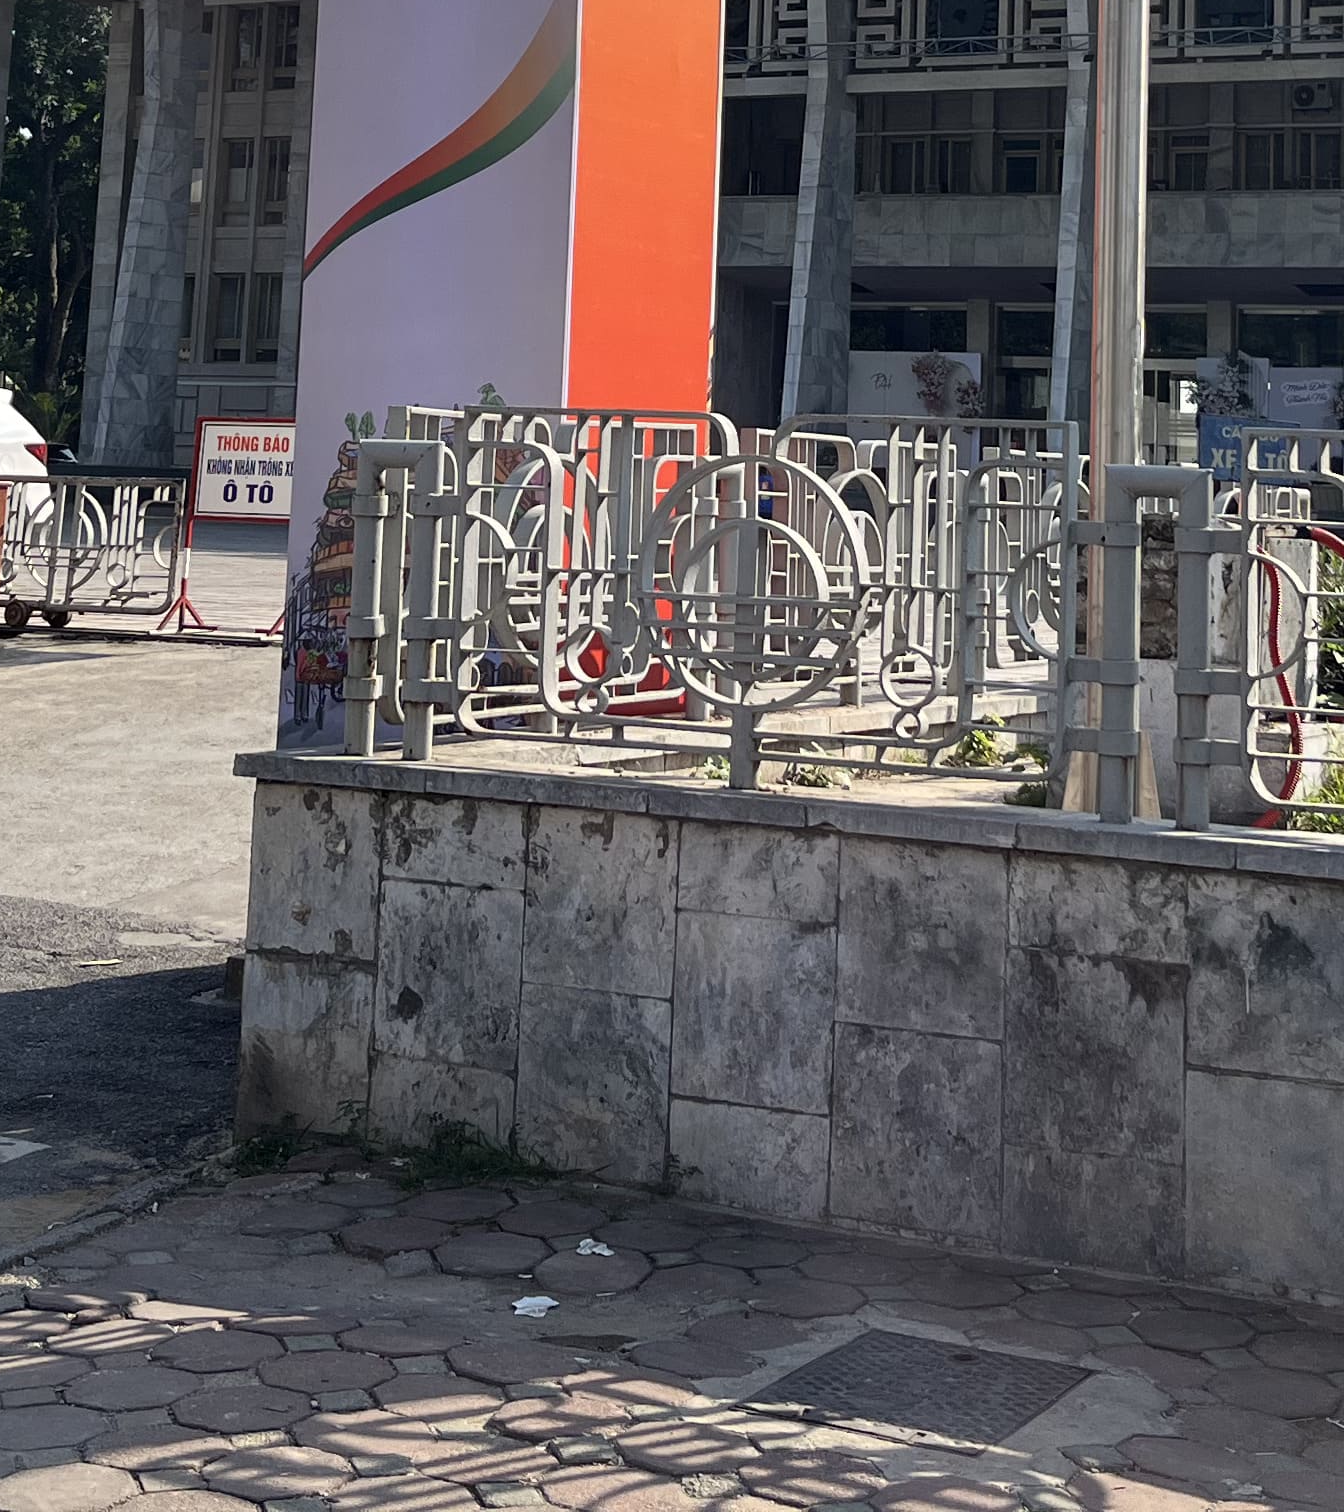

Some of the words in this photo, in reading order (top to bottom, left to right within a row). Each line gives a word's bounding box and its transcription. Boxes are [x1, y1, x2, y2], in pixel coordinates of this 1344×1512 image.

[217, 432, 259, 452] THÔNG
[263, 433, 290, 453] BÁO
[223, 479, 238, 502] Ô
[246, 480, 274, 504] TÔ
